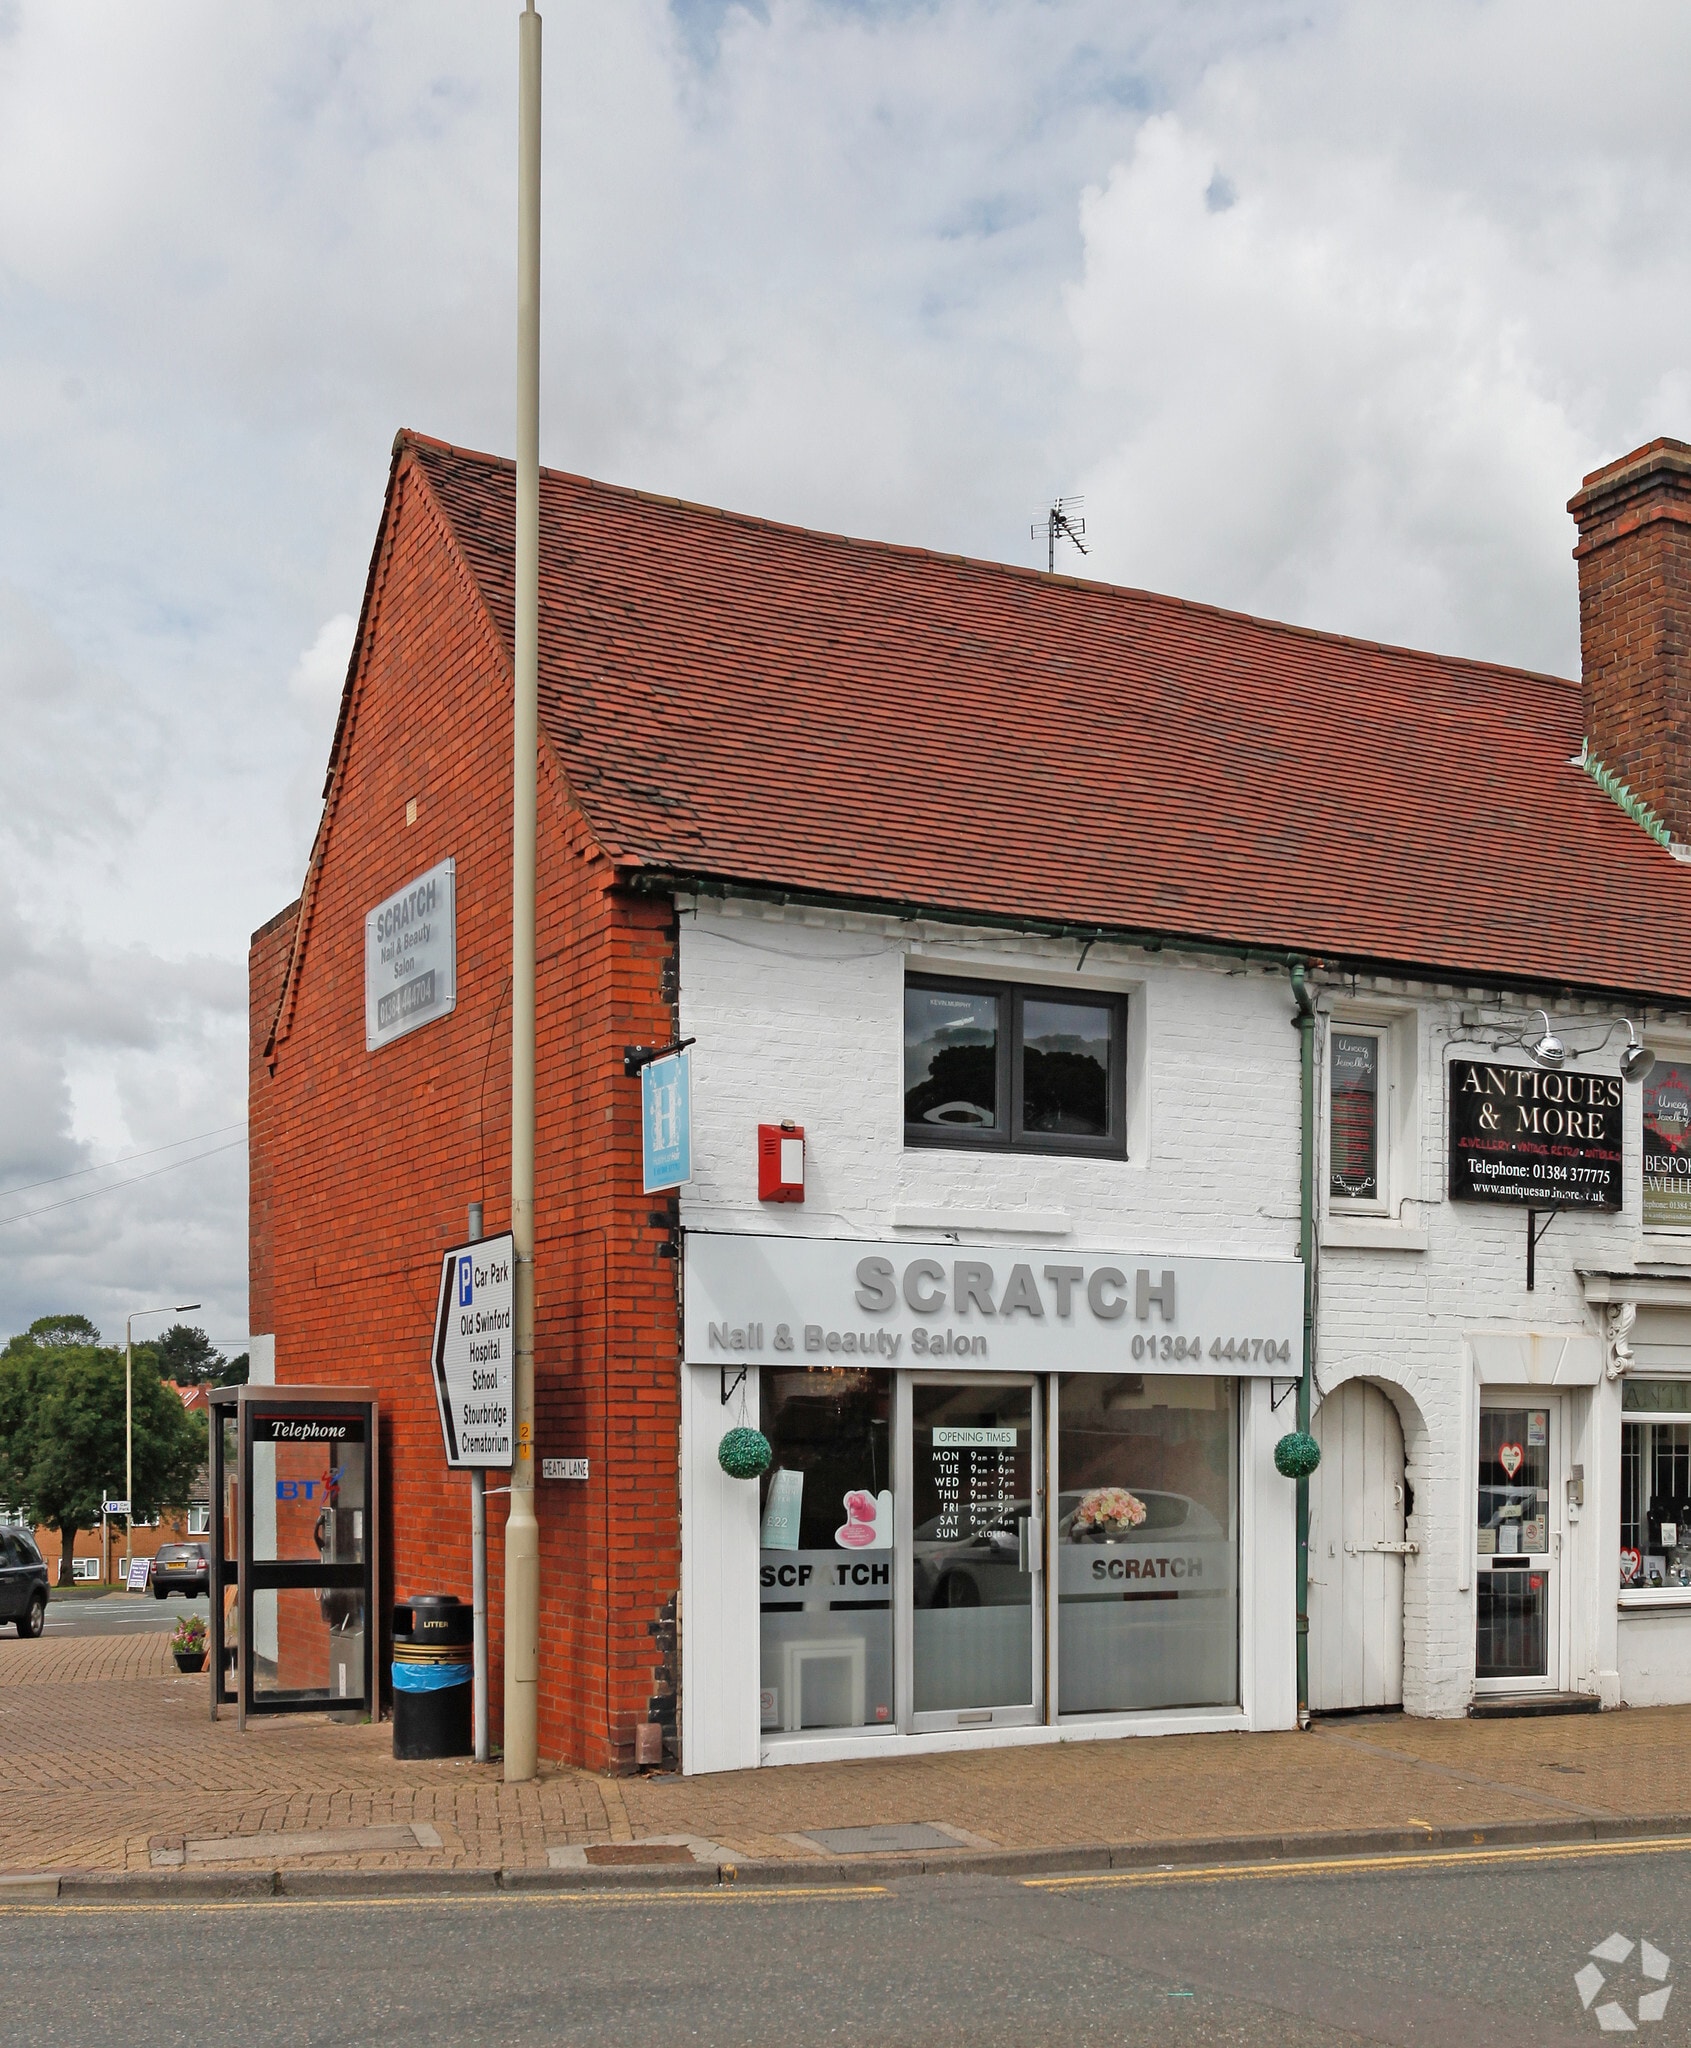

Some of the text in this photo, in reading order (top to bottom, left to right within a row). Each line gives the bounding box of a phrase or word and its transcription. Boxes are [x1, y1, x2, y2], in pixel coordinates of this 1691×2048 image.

[377, 879, 436, 943] SCRATCH
[381, 923, 431, 965] Nail & Beauty
[394, 957, 415, 979] Salon
[380, 977, 431, 1023] 01384 444704
[1335, 1055, 1375, 1074] Jewellery
[1461, 1065, 1621, 1107] ANTIQUES
[1479, 1102, 1605, 1139] & MORE
[1458, 1137, 1511, 1152] JEWELLERY
[1468, 1158, 1611, 1184] Telephone: 01384 377775
[474, 1267, 488, 1288] Car
[491, 1260, 509, 1284] Park
[854, 1256, 1176, 1320] SCRATCH
[460, 1306, 510, 1336] Old Swinford
[708, 1321, 987, 1360] Nail & Beauty Salon
[1131, 1334, 1291, 1363] 01384 444704
[469, 1338, 501, 1365] Hospital
[472, 1368, 498, 1391] School
[463, 1402, 507, 1427] Stourbridge
[271, 1421, 346, 1440] Telephone
[521, 1427, 529, 1437] 2
[939, 1432, 1011, 1442] OPENING TIMES
[462, 1432, 509, 1453] Crematorium
[523, 1444, 527, 1453] 1
[932, 1452, 959, 1461] MON
[970, 1452, 987, 1461] 9am
[998, 1452, 1014, 1462] 6pm
[543, 1461, 587, 1476] HEATH LANE
[940, 1464, 959, 1474] TUE
[970, 1464, 987, 1474] 9am
[998, 1464, 1014, 1474] 6pm
[276, 1480, 321, 1500] BT
[934, 1477, 959, 1486] WED
[970, 1477, 987, 1486] 9am
[998, 1477, 1014, 1487] 7pm
[938, 1490, 959, 1499] THU
[970, 1490, 987, 1499] 9am
[998, 1490, 1014, 1500] 8pm
[943, 1503, 959, 1512] FRI
[970, 1503, 987, 1512] 9am
[998, 1503, 1014, 1513] 5pm
[766, 1516, 788, 1528] £22
[940, 1516, 959, 1525] SAT
[970, 1516, 987, 1525] 9am
[998, 1516, 1014, 1526] 4pm
[936, 1529, 958, 1538] SUN
[760, 1564, 889, 1587] SCRTCH
[1092, 1558, 1203, 1580] SCRATCH
